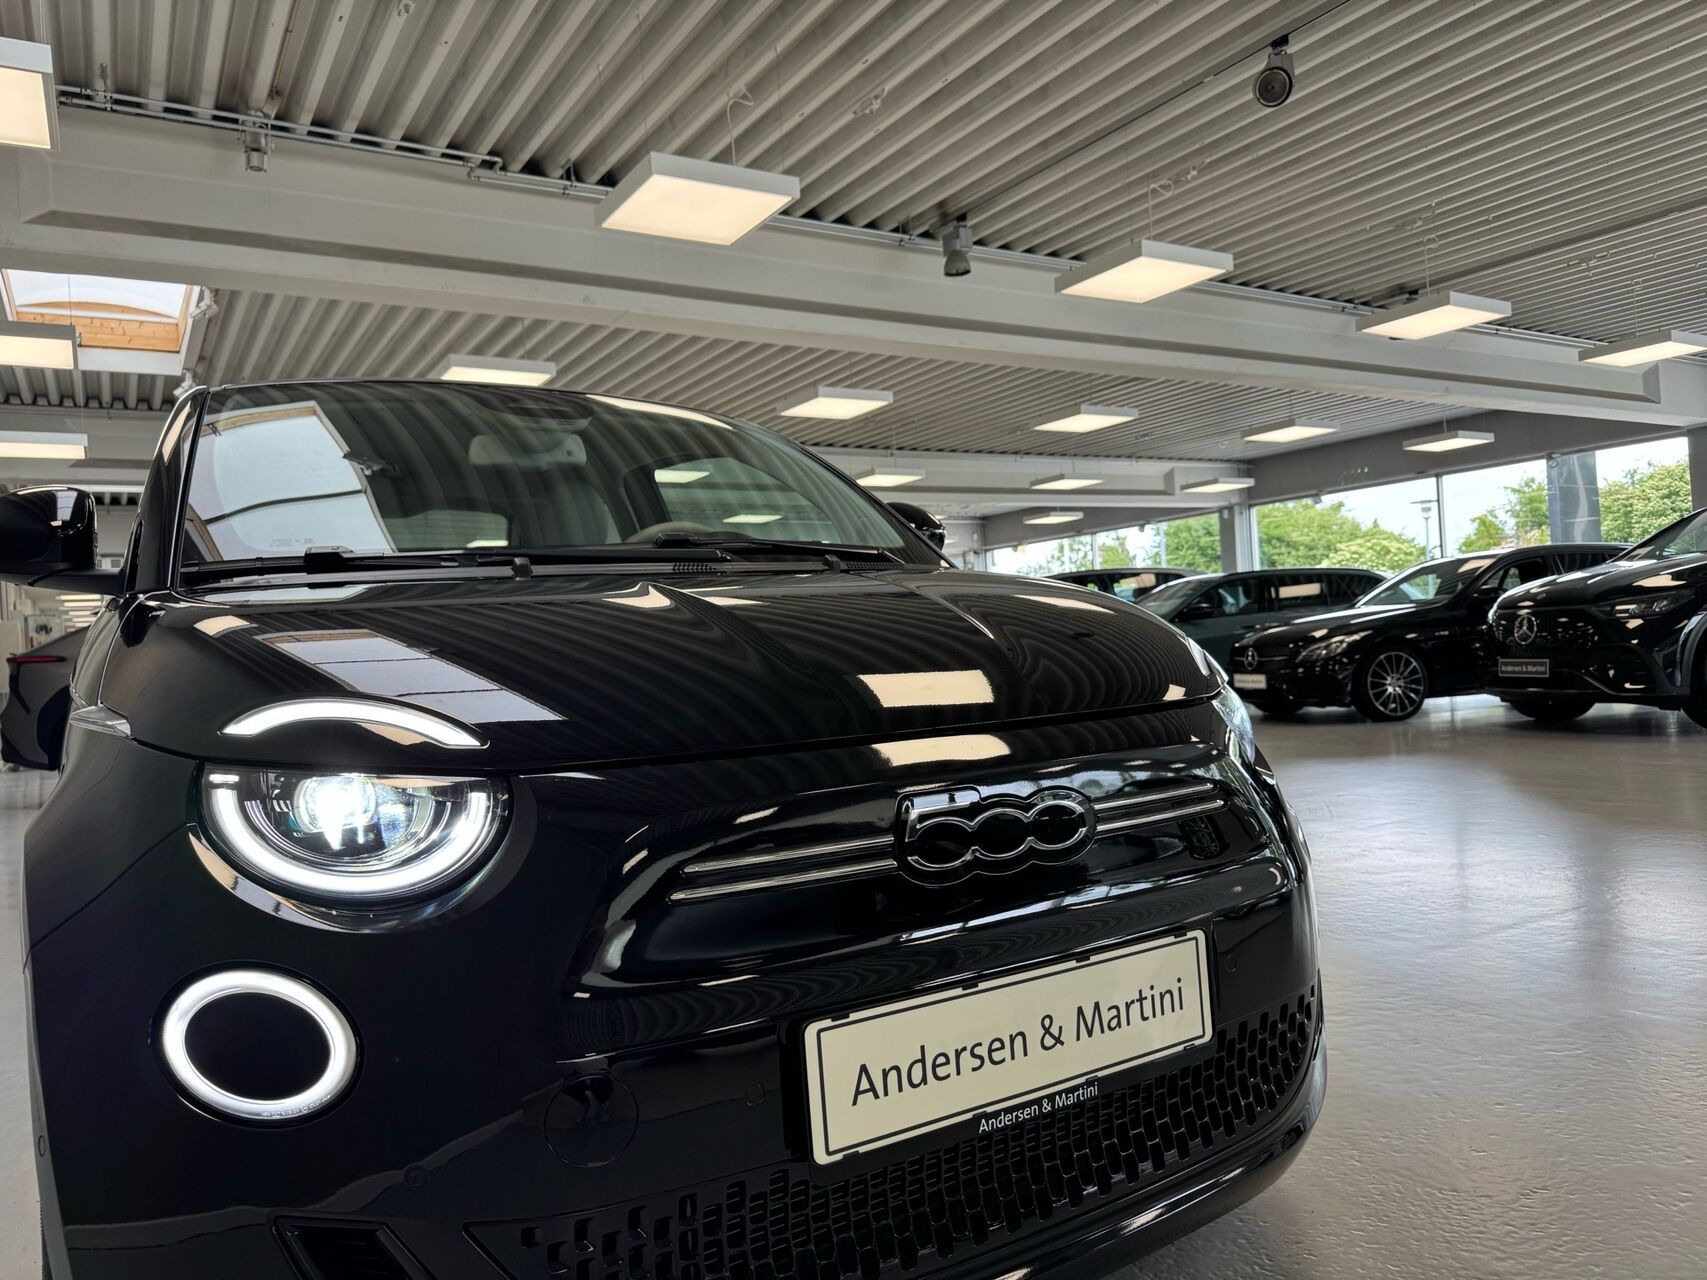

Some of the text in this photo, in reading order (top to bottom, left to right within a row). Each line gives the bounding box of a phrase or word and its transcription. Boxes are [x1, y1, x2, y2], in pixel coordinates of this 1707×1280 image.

[852, 977, 1184, 1107] Andersen & Martini
[978, 1081, 1098, 1134] Andersen & Martini
